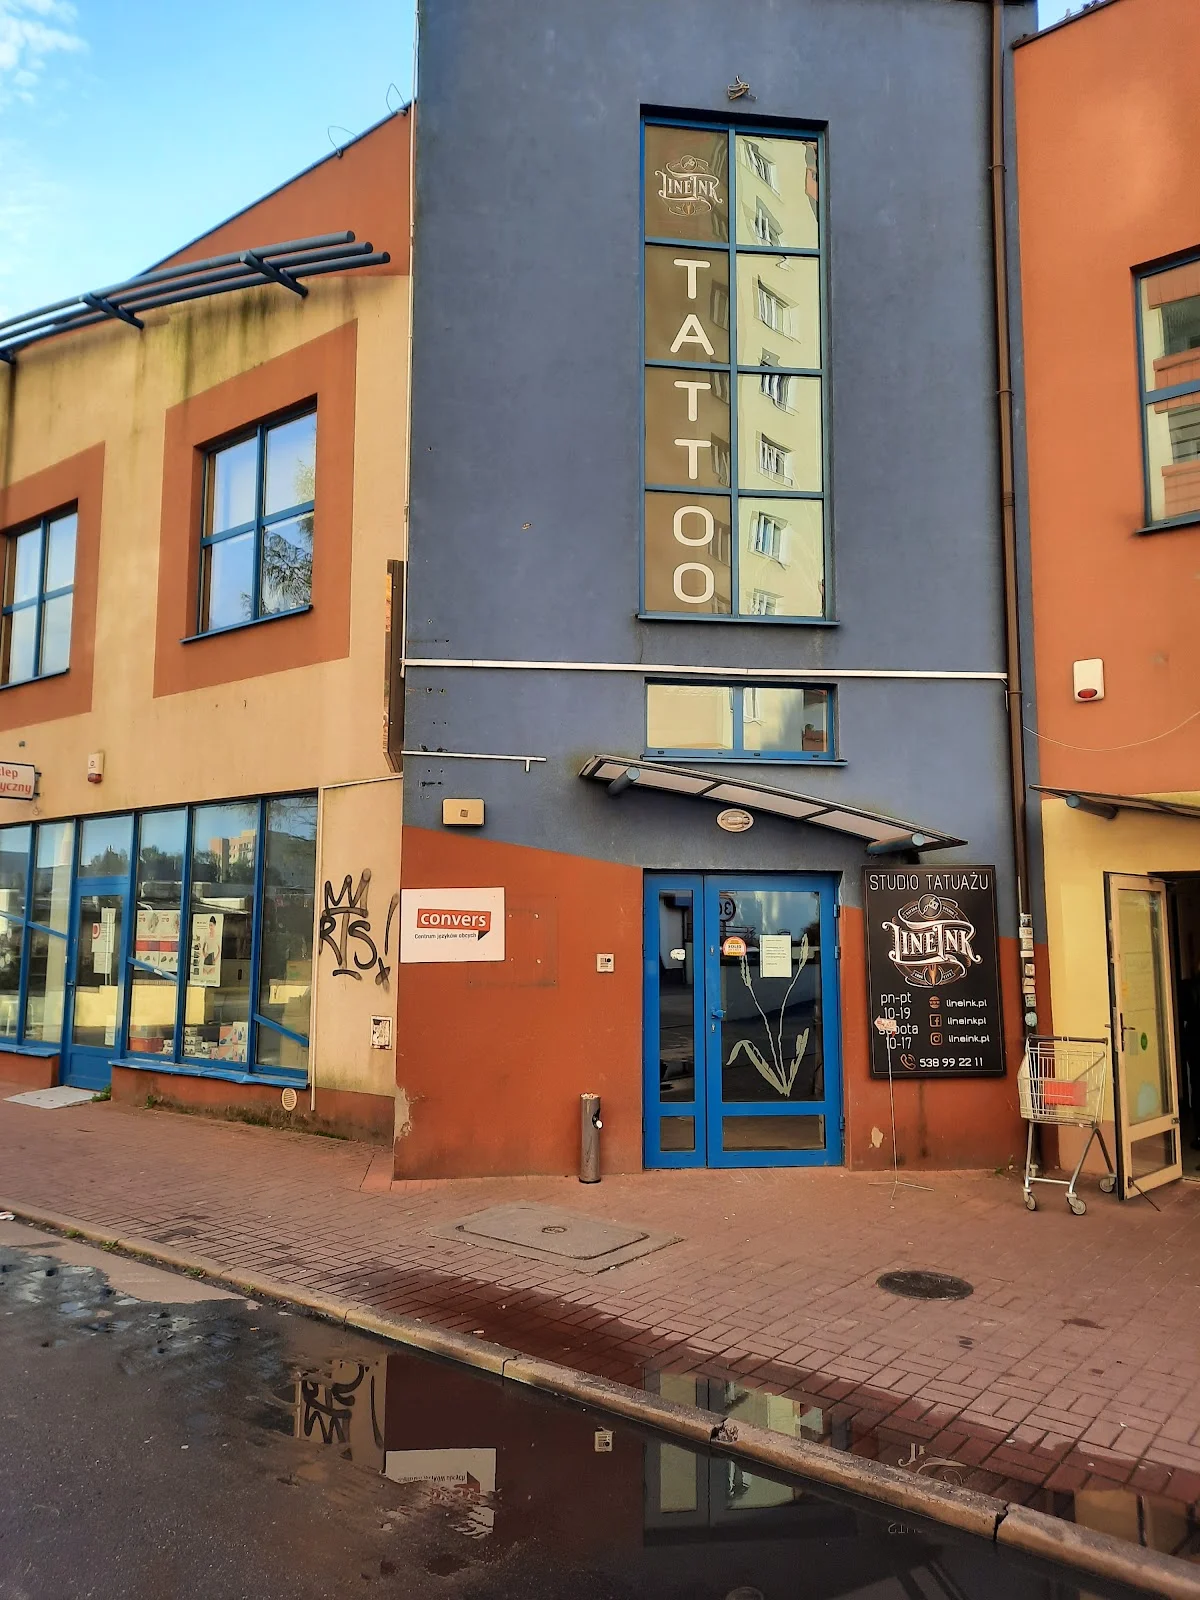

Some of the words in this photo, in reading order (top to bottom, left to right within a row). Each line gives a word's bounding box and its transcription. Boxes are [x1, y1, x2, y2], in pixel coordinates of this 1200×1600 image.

[670, 258, 715, 604] TATTOO
[869, 874, 919, 890] STUDIO
[925, 871, 989, 890] TATUAŻU
[420, 913, 487, 928] convers
[880, 992, 912, 1006] pn-pt
[884, 1006, 911, 1020] 10-19
[878, 1022, 919, 1035] ota
[886, 1036, 912, 1050] 10-17
[919, 1058, 940, 1068] 538
[942, 1058, 956, 1068] 99
[958, 1057, 972, 1067] 22
[974, 1056, 983, 1067] 11
